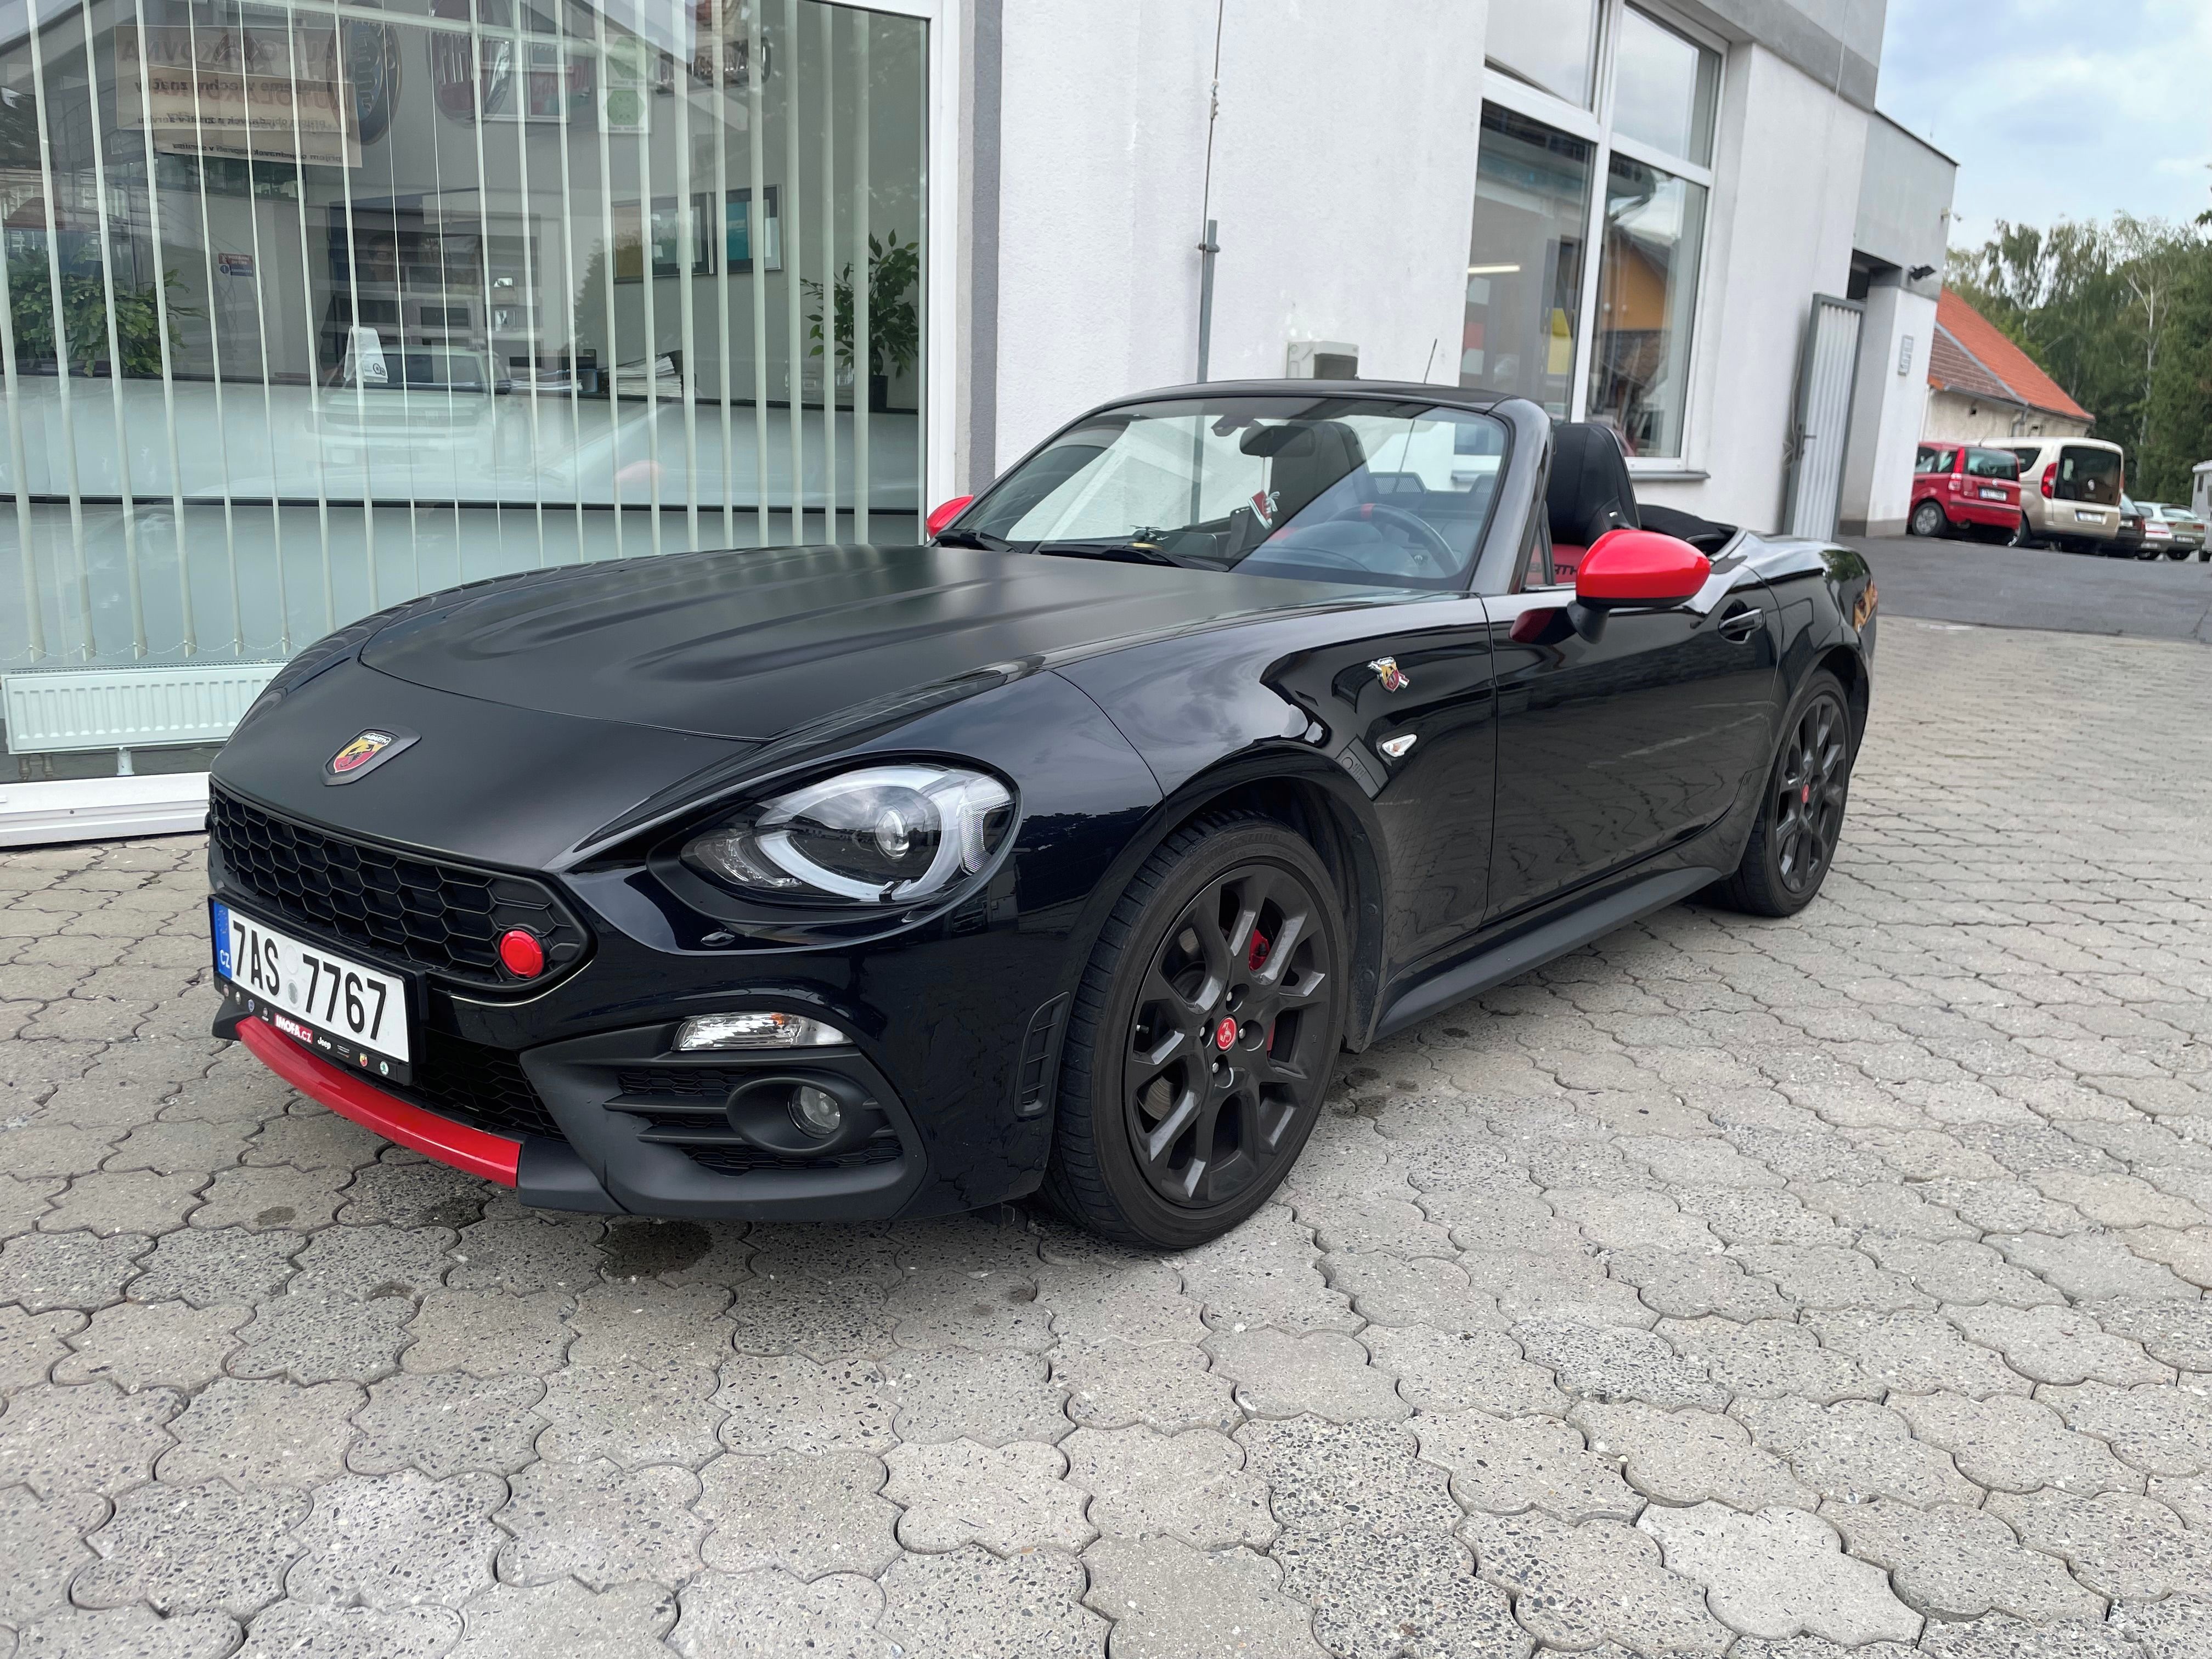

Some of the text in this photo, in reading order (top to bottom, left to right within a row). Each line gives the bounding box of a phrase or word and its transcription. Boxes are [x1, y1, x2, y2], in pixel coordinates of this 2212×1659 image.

[220, 949, 230, 968] CZ
[233, 920, 386, 1041] 7AS 7767
[317, 1036, 331, 1050] Jeep
